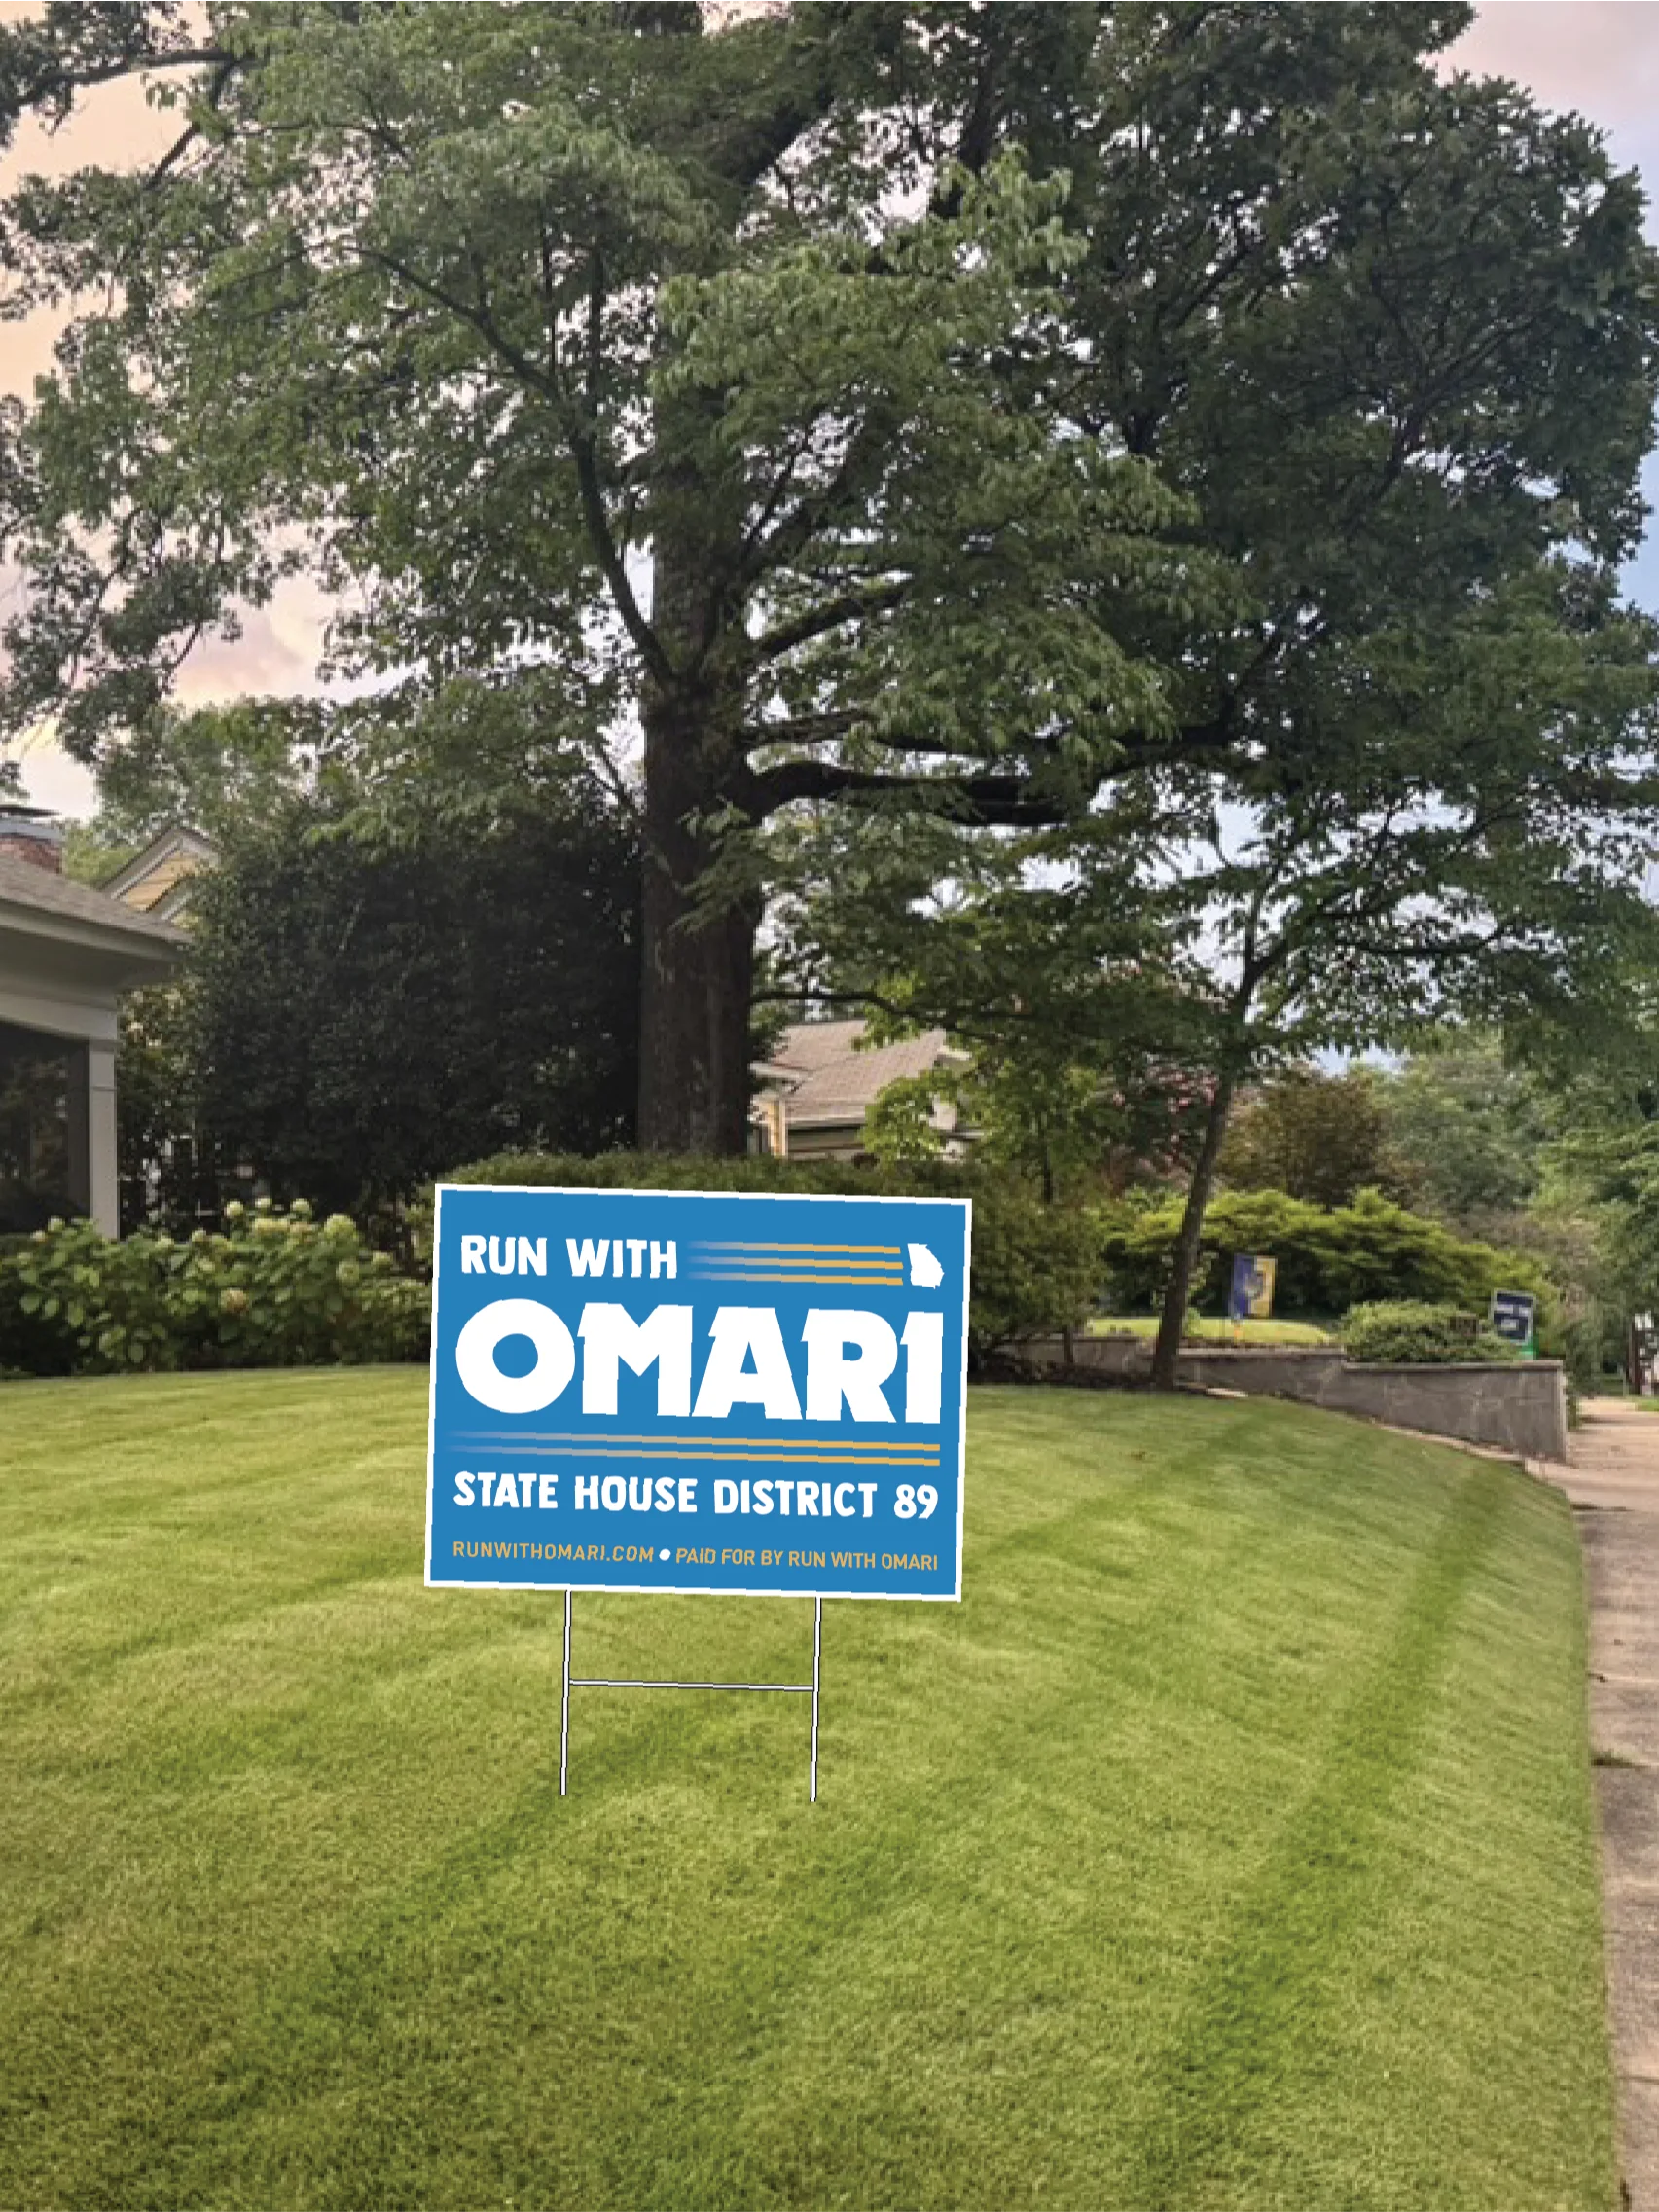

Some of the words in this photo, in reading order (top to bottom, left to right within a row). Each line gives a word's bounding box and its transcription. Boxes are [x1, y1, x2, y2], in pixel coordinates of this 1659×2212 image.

[461, 1235, 547, 1276] RUN
[566, 1238, 677, 1279] WITH
[455, 1298, 943, 1424] OMARI
[453, 1471, 559, 1508] STATE
[575, 1475, 698, 1512] HOUSE
[714, 1479, 878, 1518] DISTRICT
[894, 1484, 938, 1519] 89
[453, 1541, 654, 1562] RUNWITHOMARI.COM
[676, 1548, 716, 1564] PAID
[722, 1549, 755, 1565] FOR
[761, 1550, 783, 1565] BY
[789, 1551, 825, 1567] RUN
[831, 1552, 875, 1568] WITH
[882, 1553, 937, 1570] OMARI
